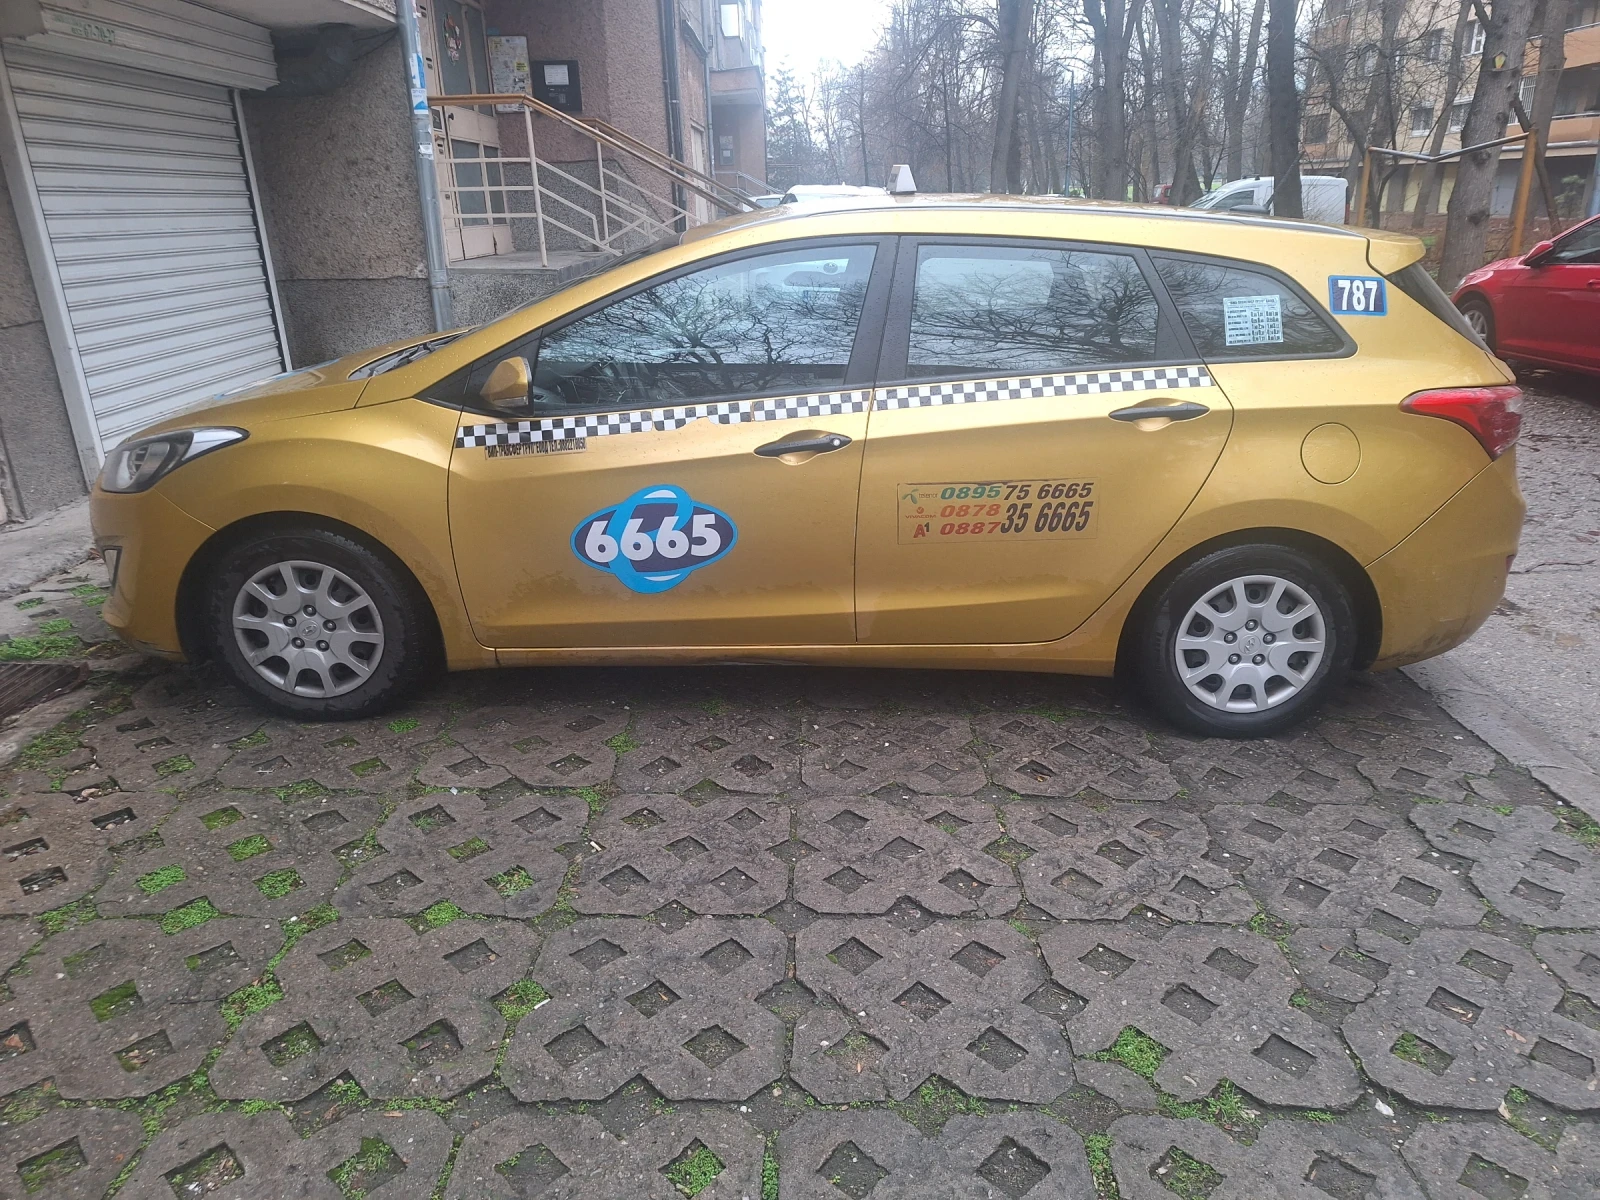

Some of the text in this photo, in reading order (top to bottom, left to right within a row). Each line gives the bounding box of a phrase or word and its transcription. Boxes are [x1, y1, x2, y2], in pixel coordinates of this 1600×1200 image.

[1338, 279, 1378, 312] 787
[940, 485, 1003, 500] 0895
[1003, 484, 1032, 501] 75
[1036, 482, 1094, 500] 6665
[913, 521, 1001, 539] A1 0887
[940, 503, 1002, 518] 0878
[1000, 502, 1033, 534] 35
[1034, 500, 1094, 533] 6665
[584, 513, 721, 563] 6665
